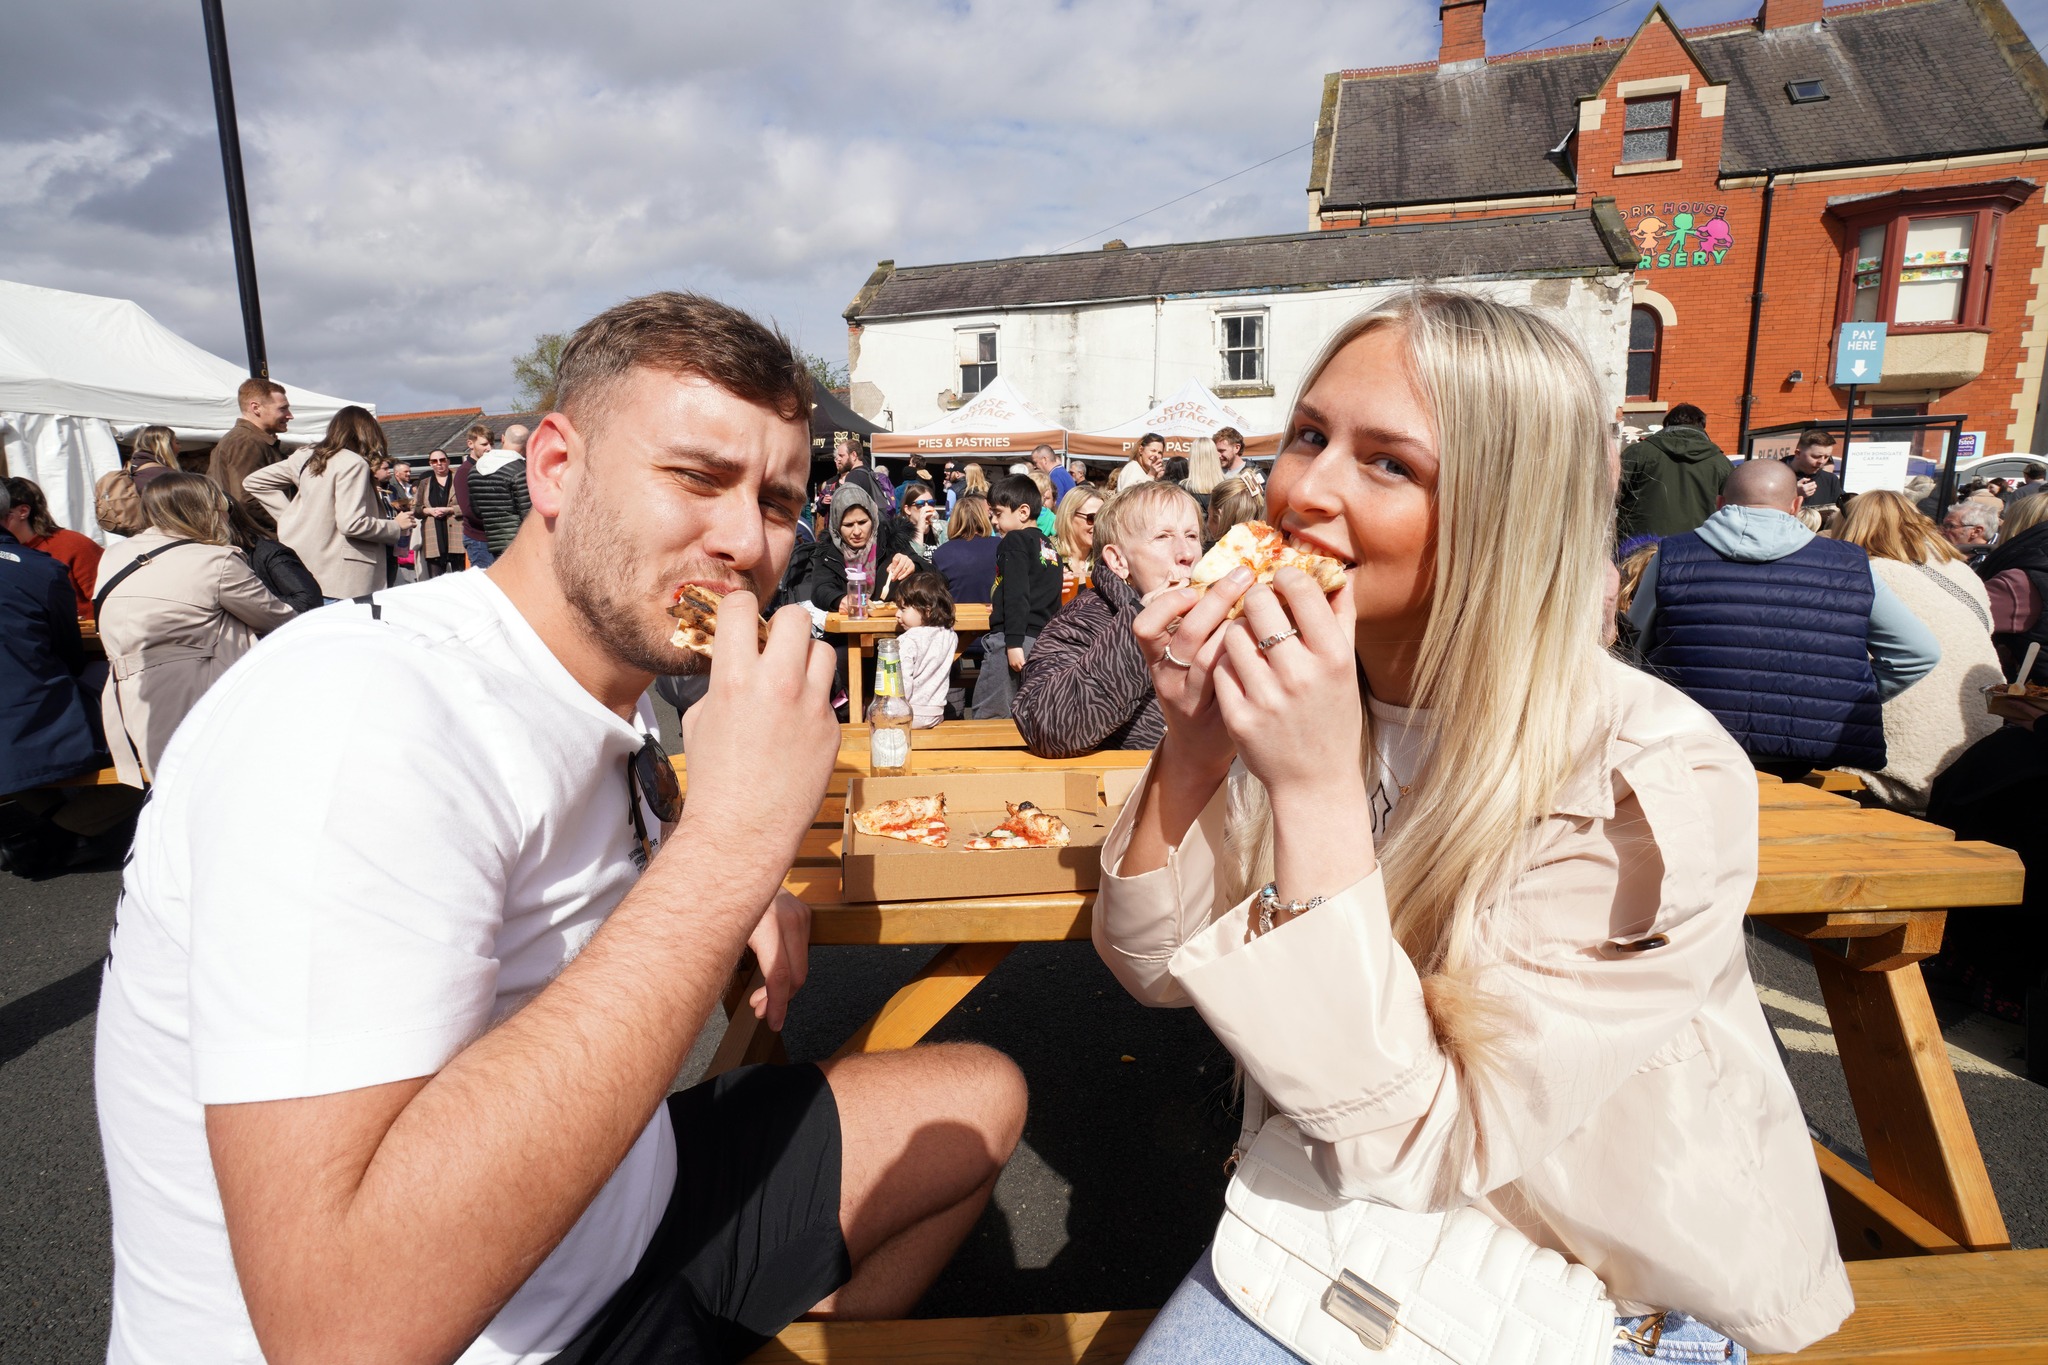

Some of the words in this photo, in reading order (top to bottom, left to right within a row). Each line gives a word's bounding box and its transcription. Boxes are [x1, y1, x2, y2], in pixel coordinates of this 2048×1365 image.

[1619, 203, 1655, 221] ORK
[1663, 202, 1728, 218] HOUSE
[1637, 249, 1728, 270] RSERY
[1852, 330, 1875, 340] PAY
[1847, 341, 1877, 350] HERE
[968, 398, 1008, 412] ROSE
[1163, 401, 1207, 415] ROSE
[950, 407, 1016, 424] COTTAGE
[1146, 410, 1220, 428] COTTAGE
[918, 438, 943, 449] PIES
[944, 438, 954, 448] &
[955, 437, 1011, 448] PASTRIES
[1758, 447, 1790, 460] PLEASE
